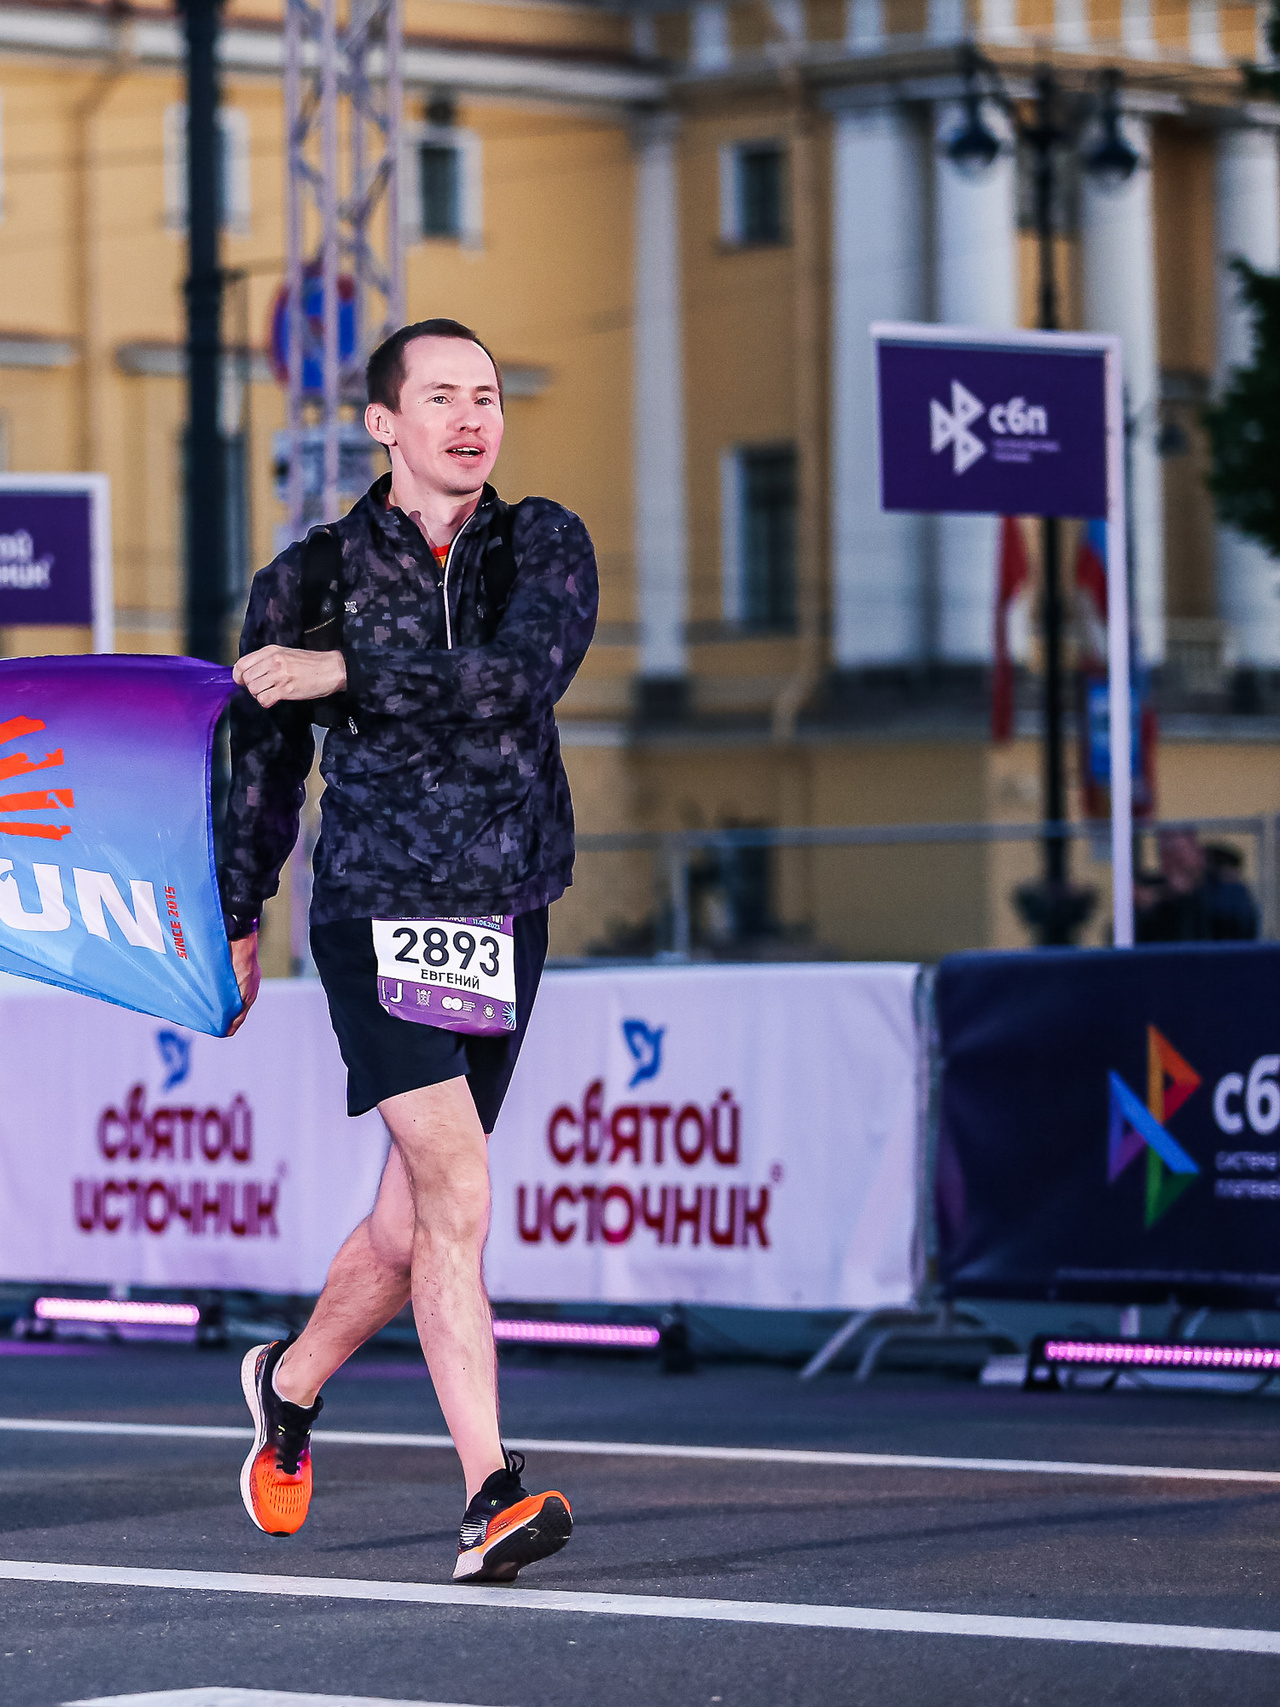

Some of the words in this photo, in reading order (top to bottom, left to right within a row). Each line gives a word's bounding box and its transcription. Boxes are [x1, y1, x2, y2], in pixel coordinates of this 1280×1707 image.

[164, 885, 180, 918] 2015
[170, 921, 188, 960] SINCE
[392, 927, 500, 977] 2893
[420, 968, 480, 990] ЕВГЕНИЙ
